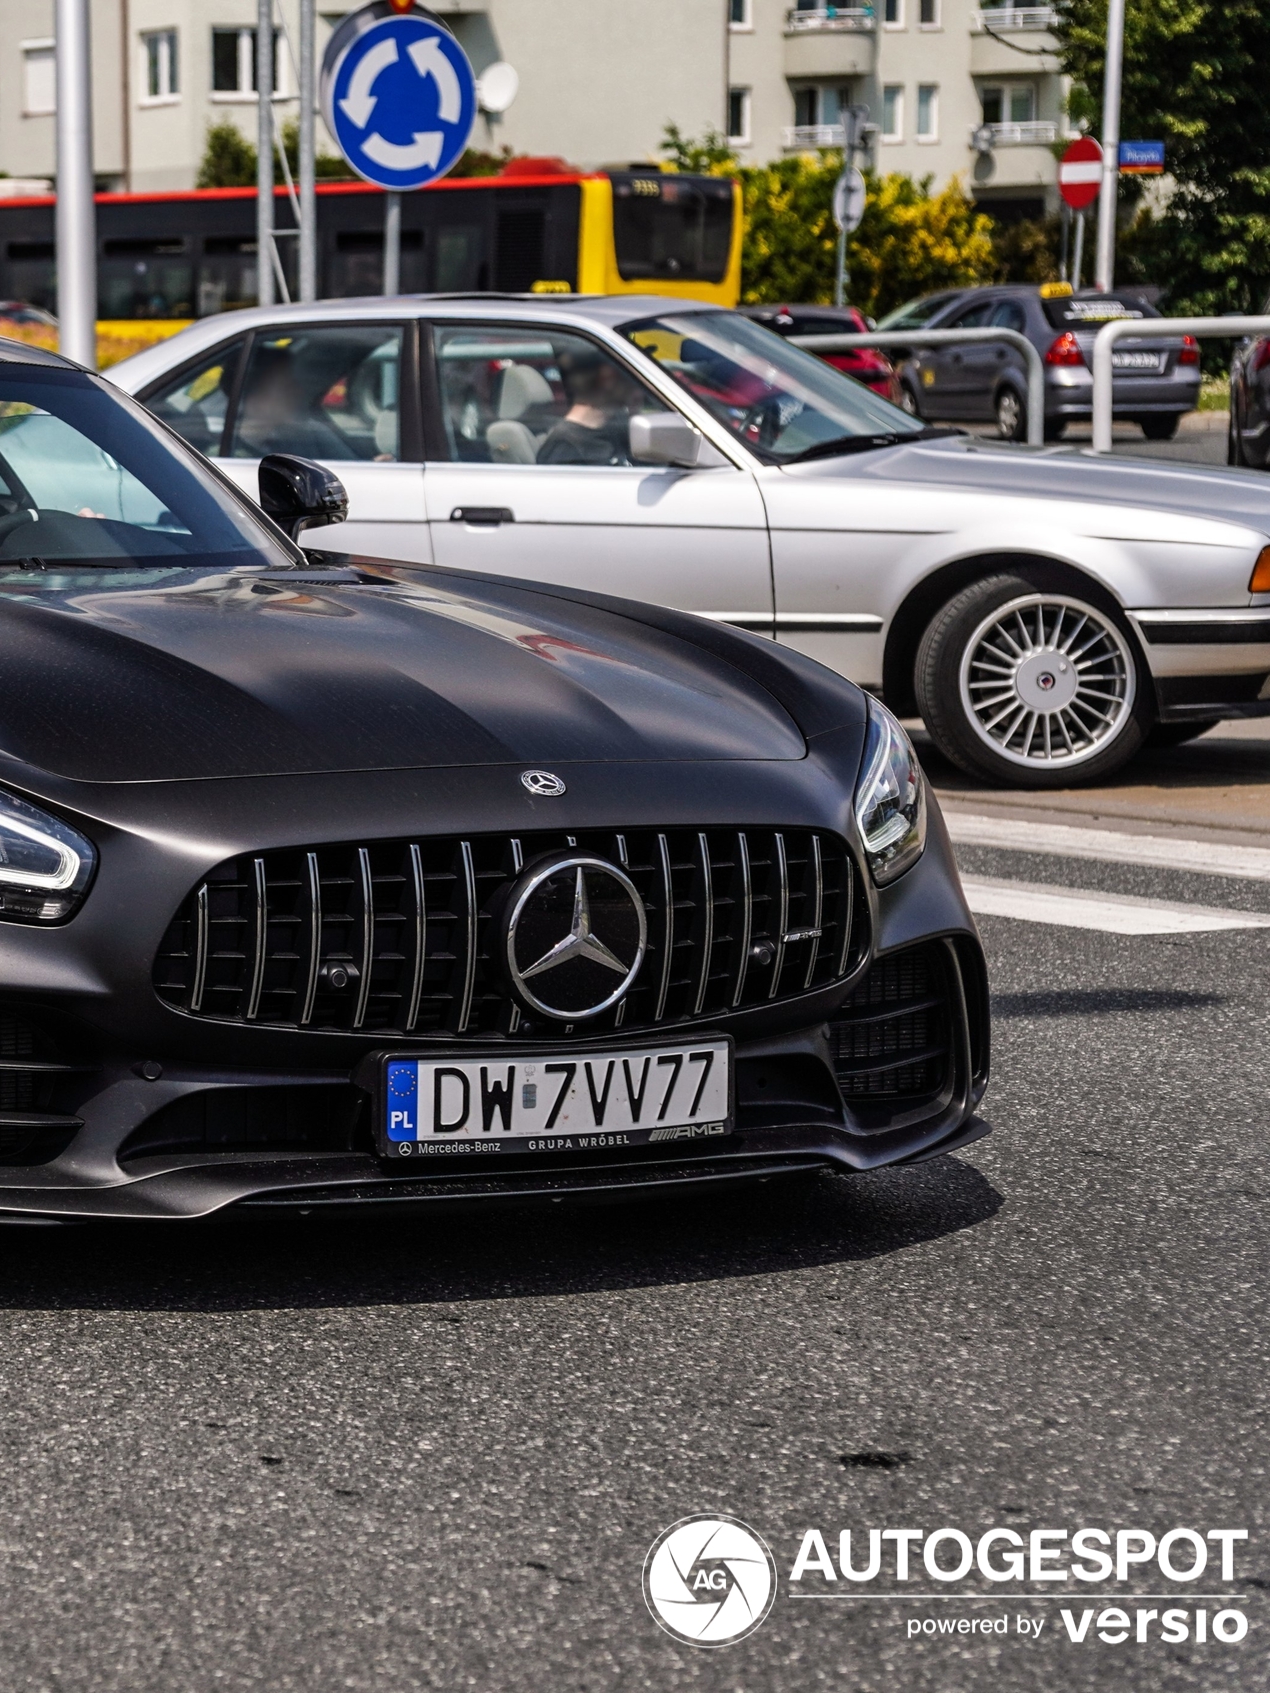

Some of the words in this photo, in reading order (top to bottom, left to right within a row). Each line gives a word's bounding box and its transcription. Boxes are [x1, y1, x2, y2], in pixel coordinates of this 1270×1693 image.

[433, 1064, 516, 1133] DW
[543, 1050, 715, 1130] 7VV77
[390, 1111, 414, 1129] PL
[418, 1141, 501, 1154] Mercedes-Benz
[528, 1139, 573, 1150] GRUPA
[579, 1134, 630, 1147] WRÓBEL
